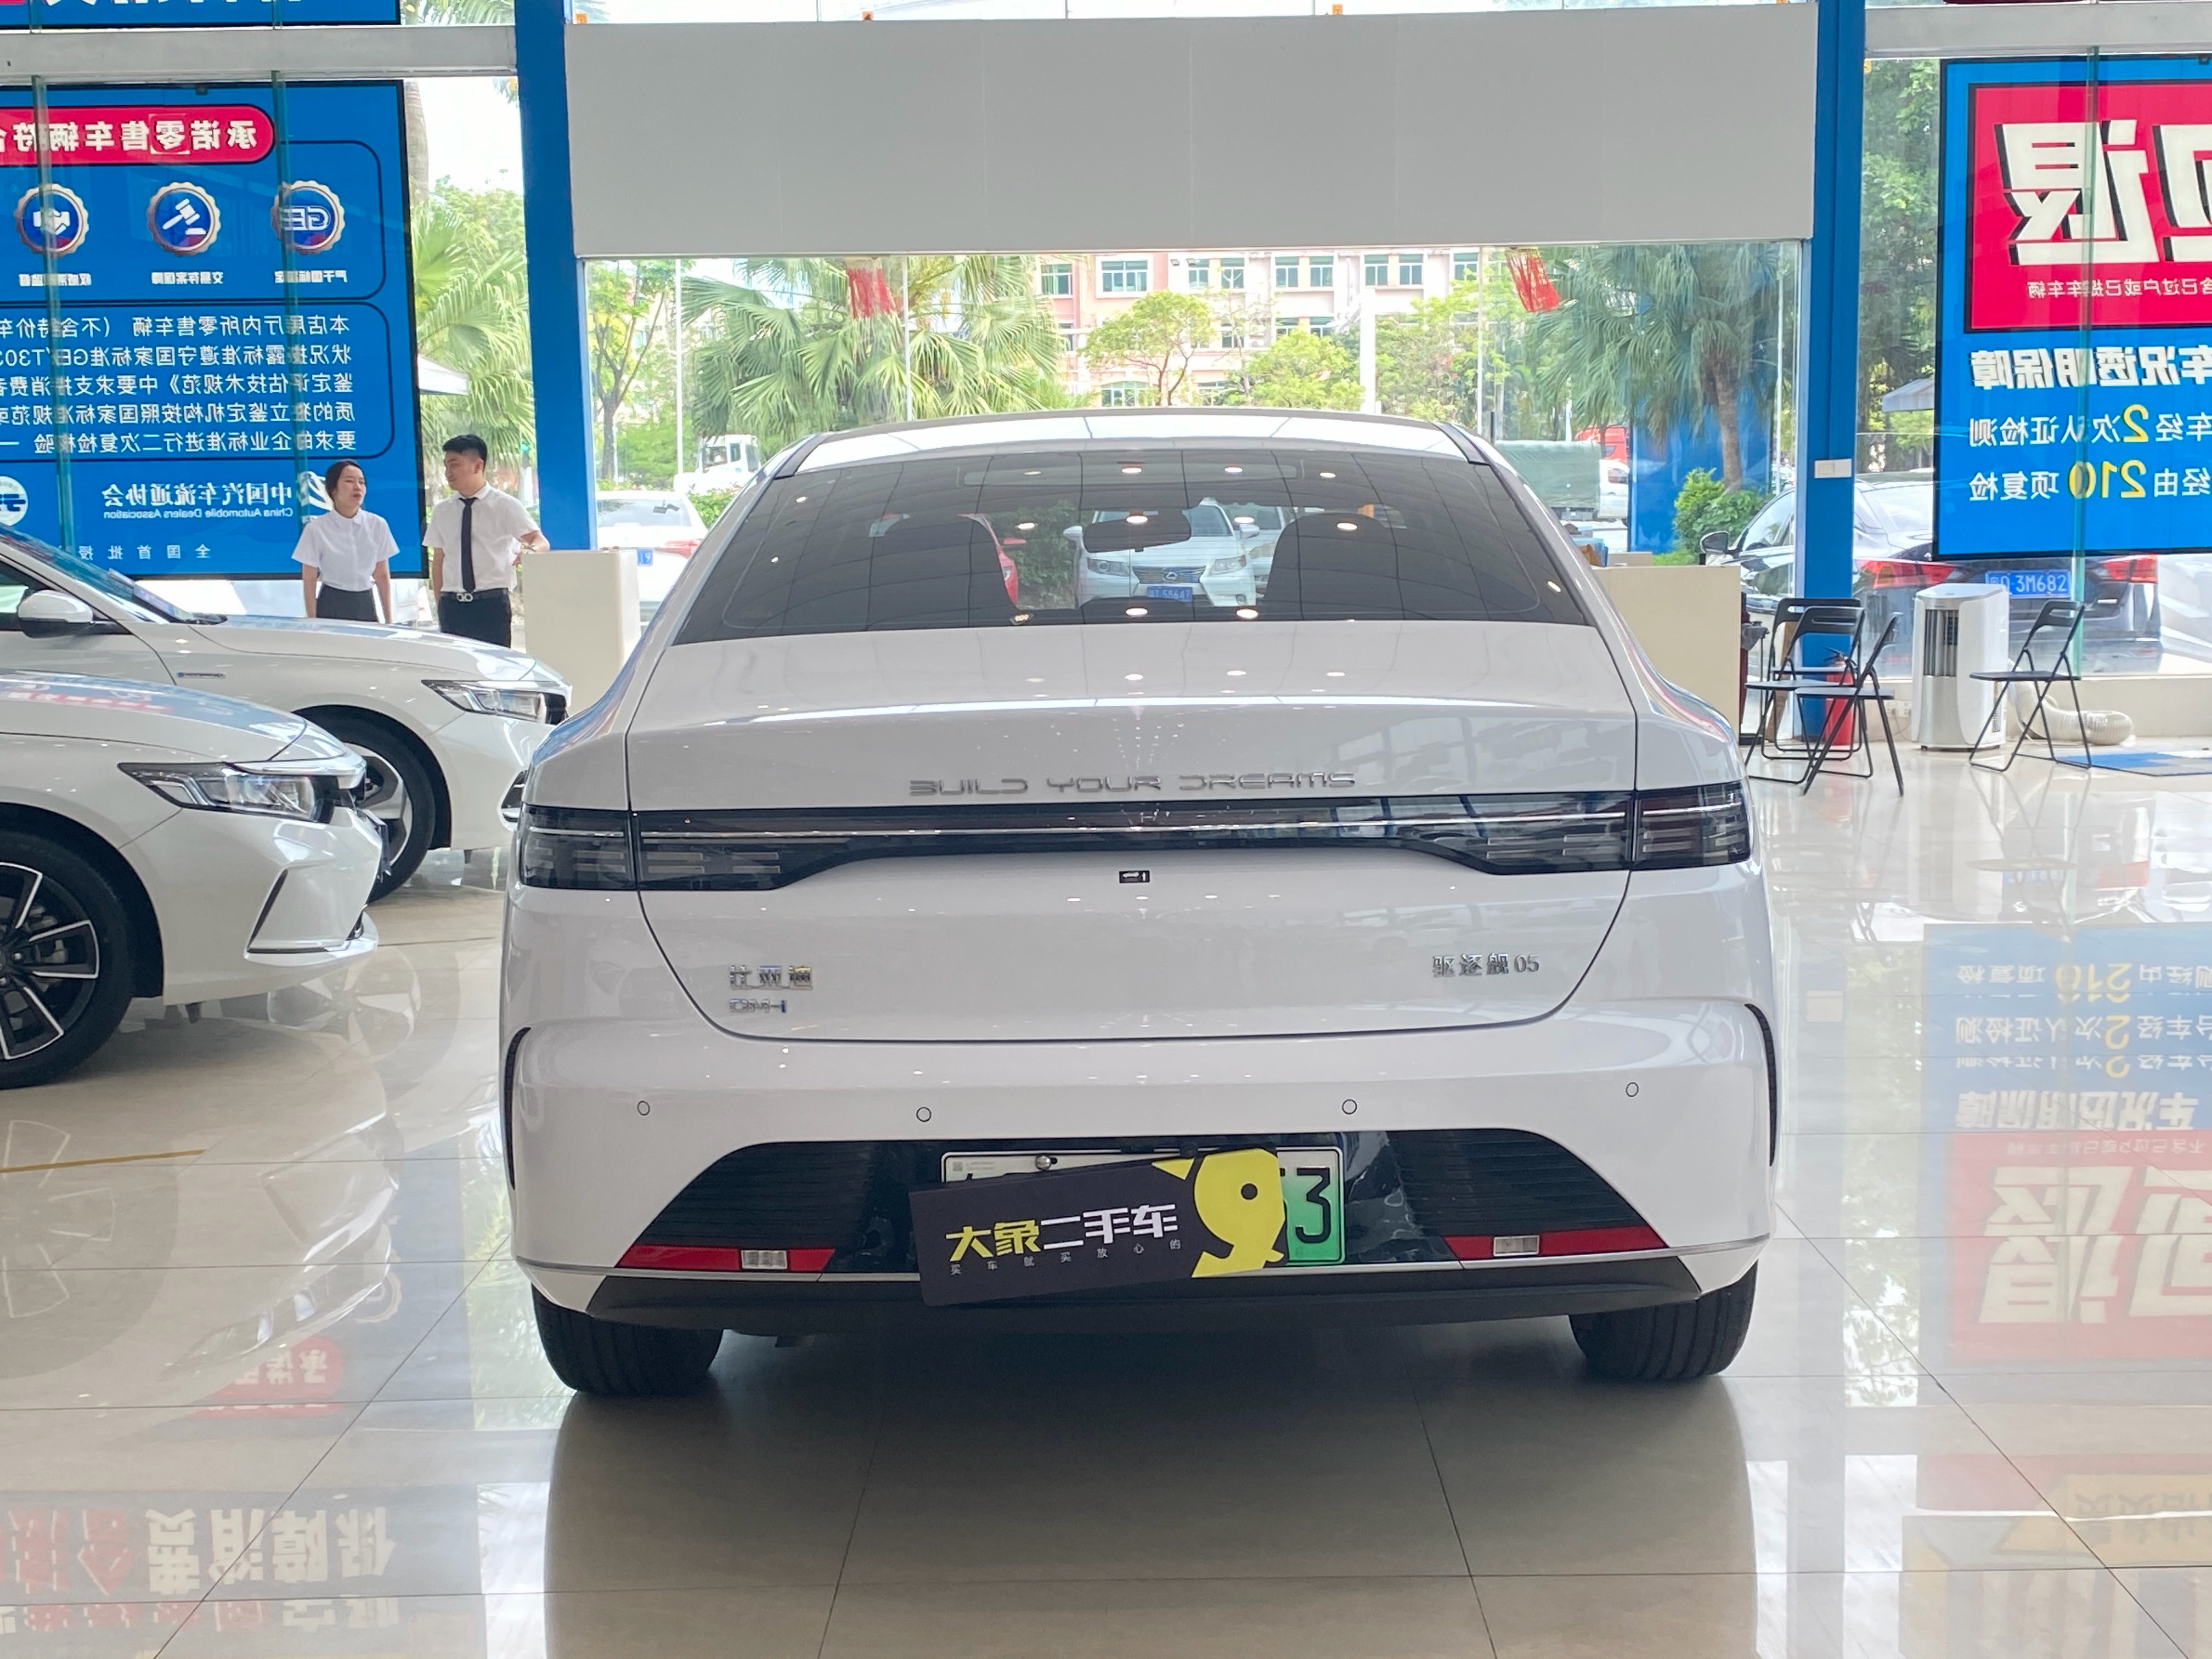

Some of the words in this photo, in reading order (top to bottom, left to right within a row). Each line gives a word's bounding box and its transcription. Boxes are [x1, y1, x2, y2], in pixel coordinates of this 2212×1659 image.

[909, 777, 1029, 797] BUILD
[1046, 774, 1163, 792] YOUR
[1180, 771, 1357, 791] DREAMS
[946, 1204, 1178, 1262] 大象二手车
